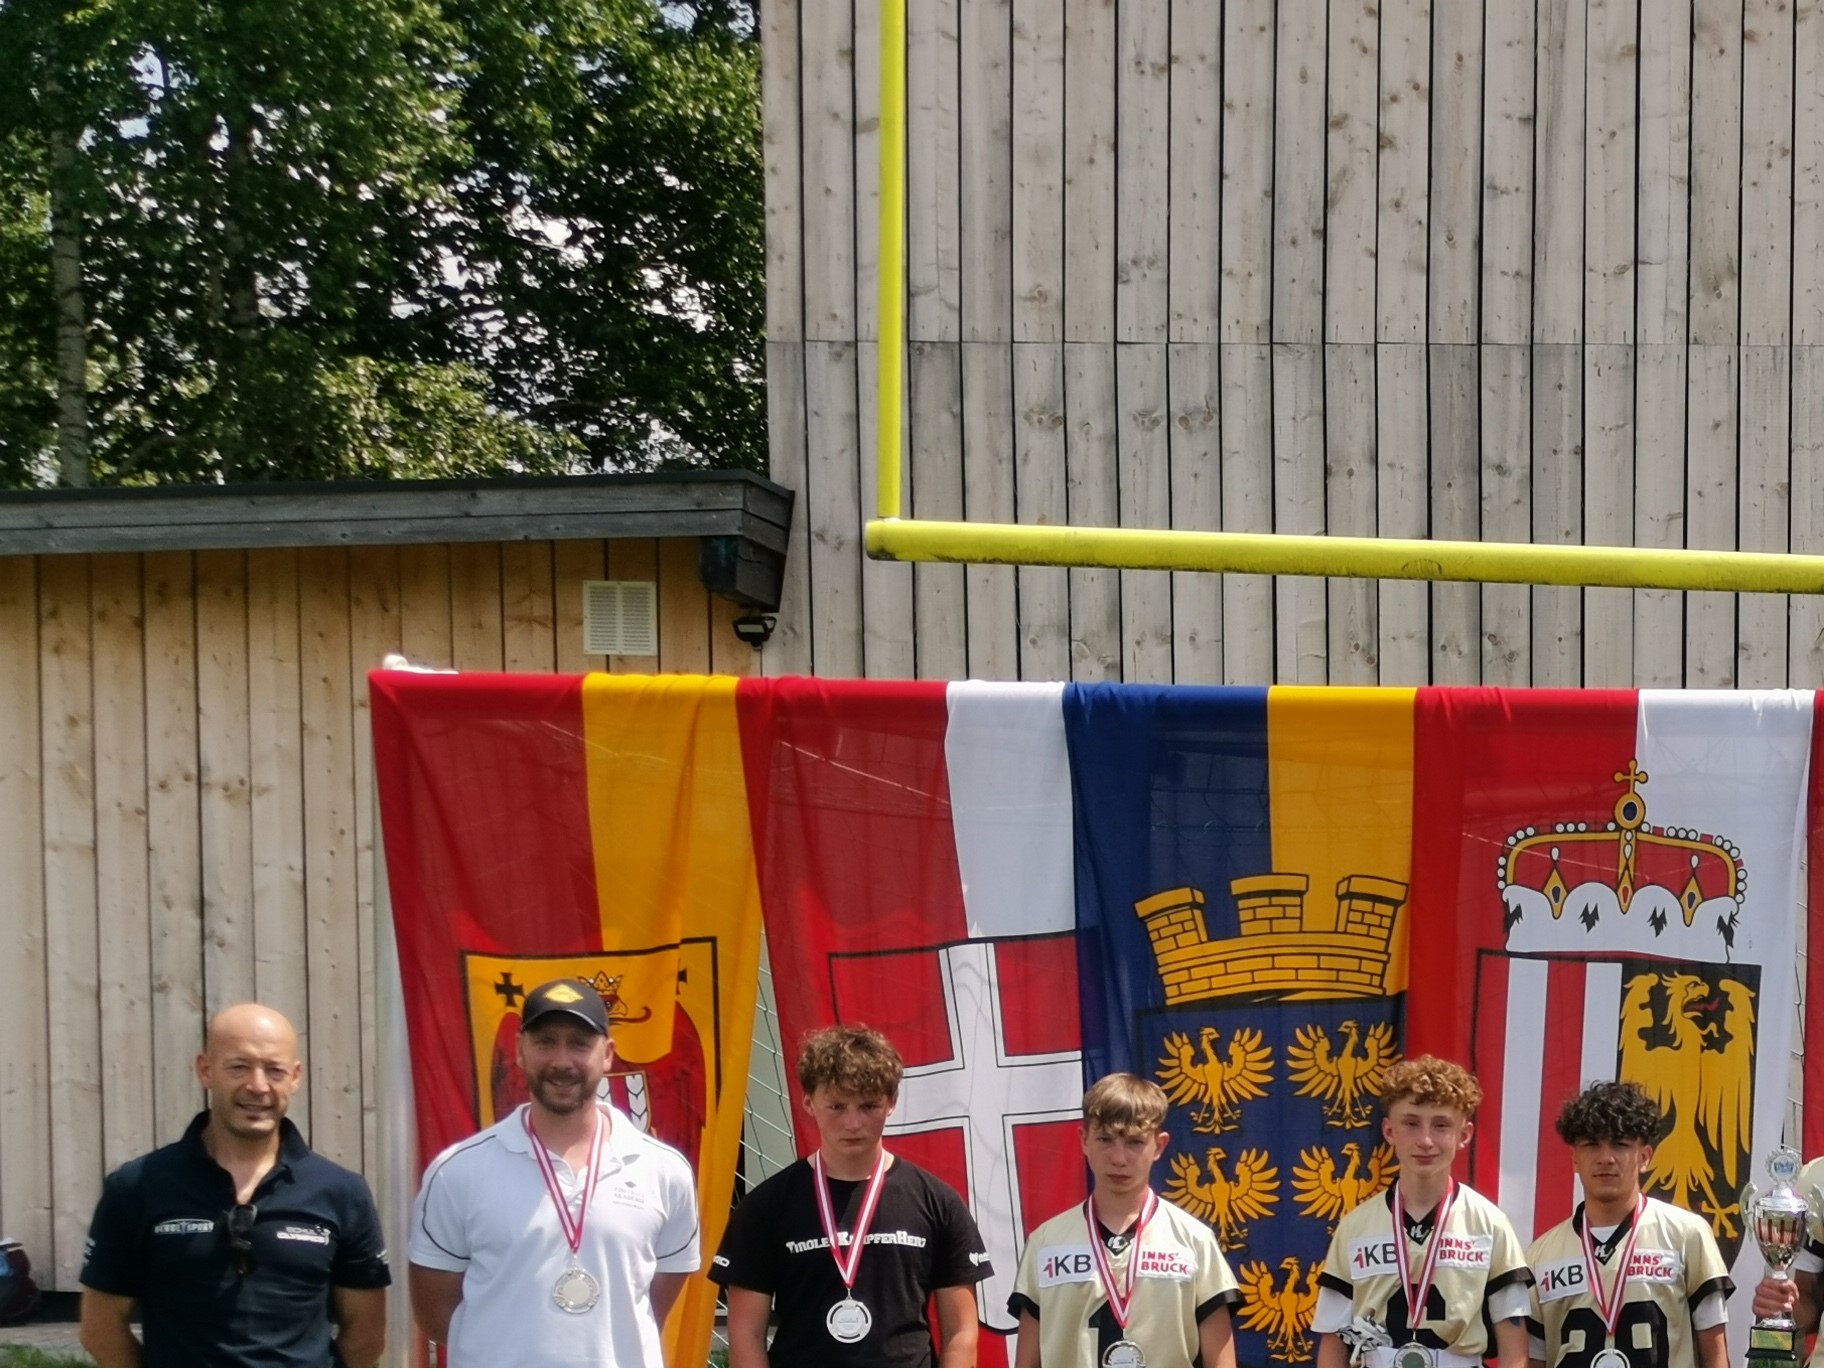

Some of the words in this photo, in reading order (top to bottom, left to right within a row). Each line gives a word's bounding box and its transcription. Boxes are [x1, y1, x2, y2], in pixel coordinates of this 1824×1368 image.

[1439, 1249, 1484, 1263] BRUCK
[1141, 1262, 1189, 1275] BRUCK
[1628, 1266, 1673, 1278] BRUCK
